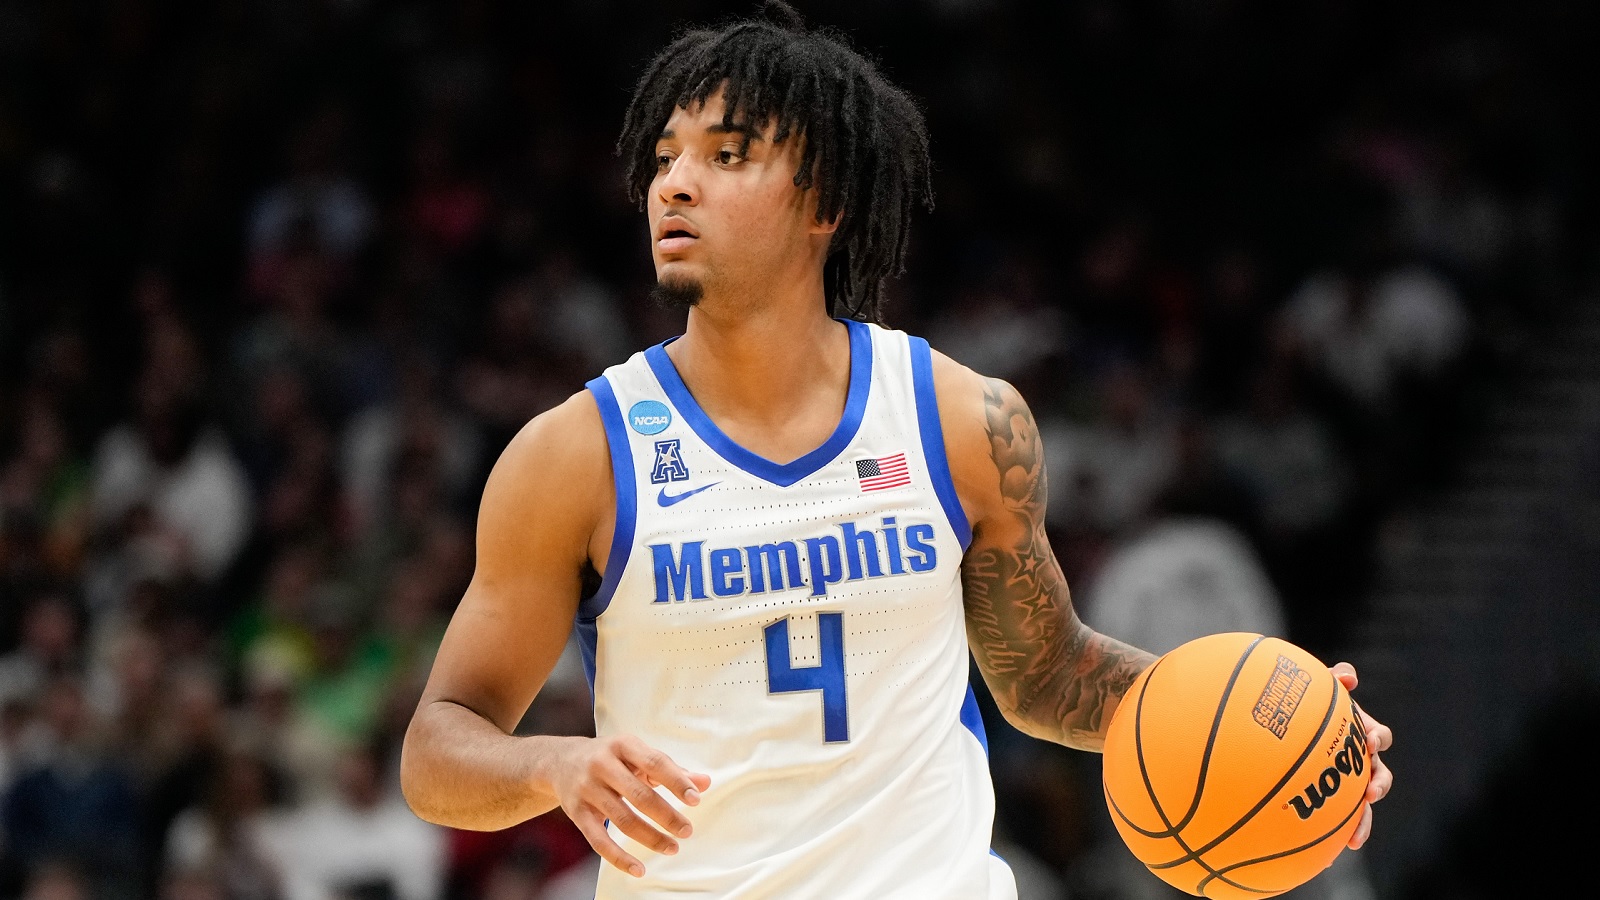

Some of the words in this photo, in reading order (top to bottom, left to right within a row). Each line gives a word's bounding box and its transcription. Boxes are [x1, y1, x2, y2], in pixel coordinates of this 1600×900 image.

[634, 416, 669, 426] NCAA
[647, 516, 938, 605] Memphis
[965, 552, 1026, 677] Haggerty
[762, 610, 850, 745] 4
[1255, 670, 1292, 728] MADNESS
[1278, 674, 1307, 717] MARCH
[1326, 738, 1340, 758] NXT
